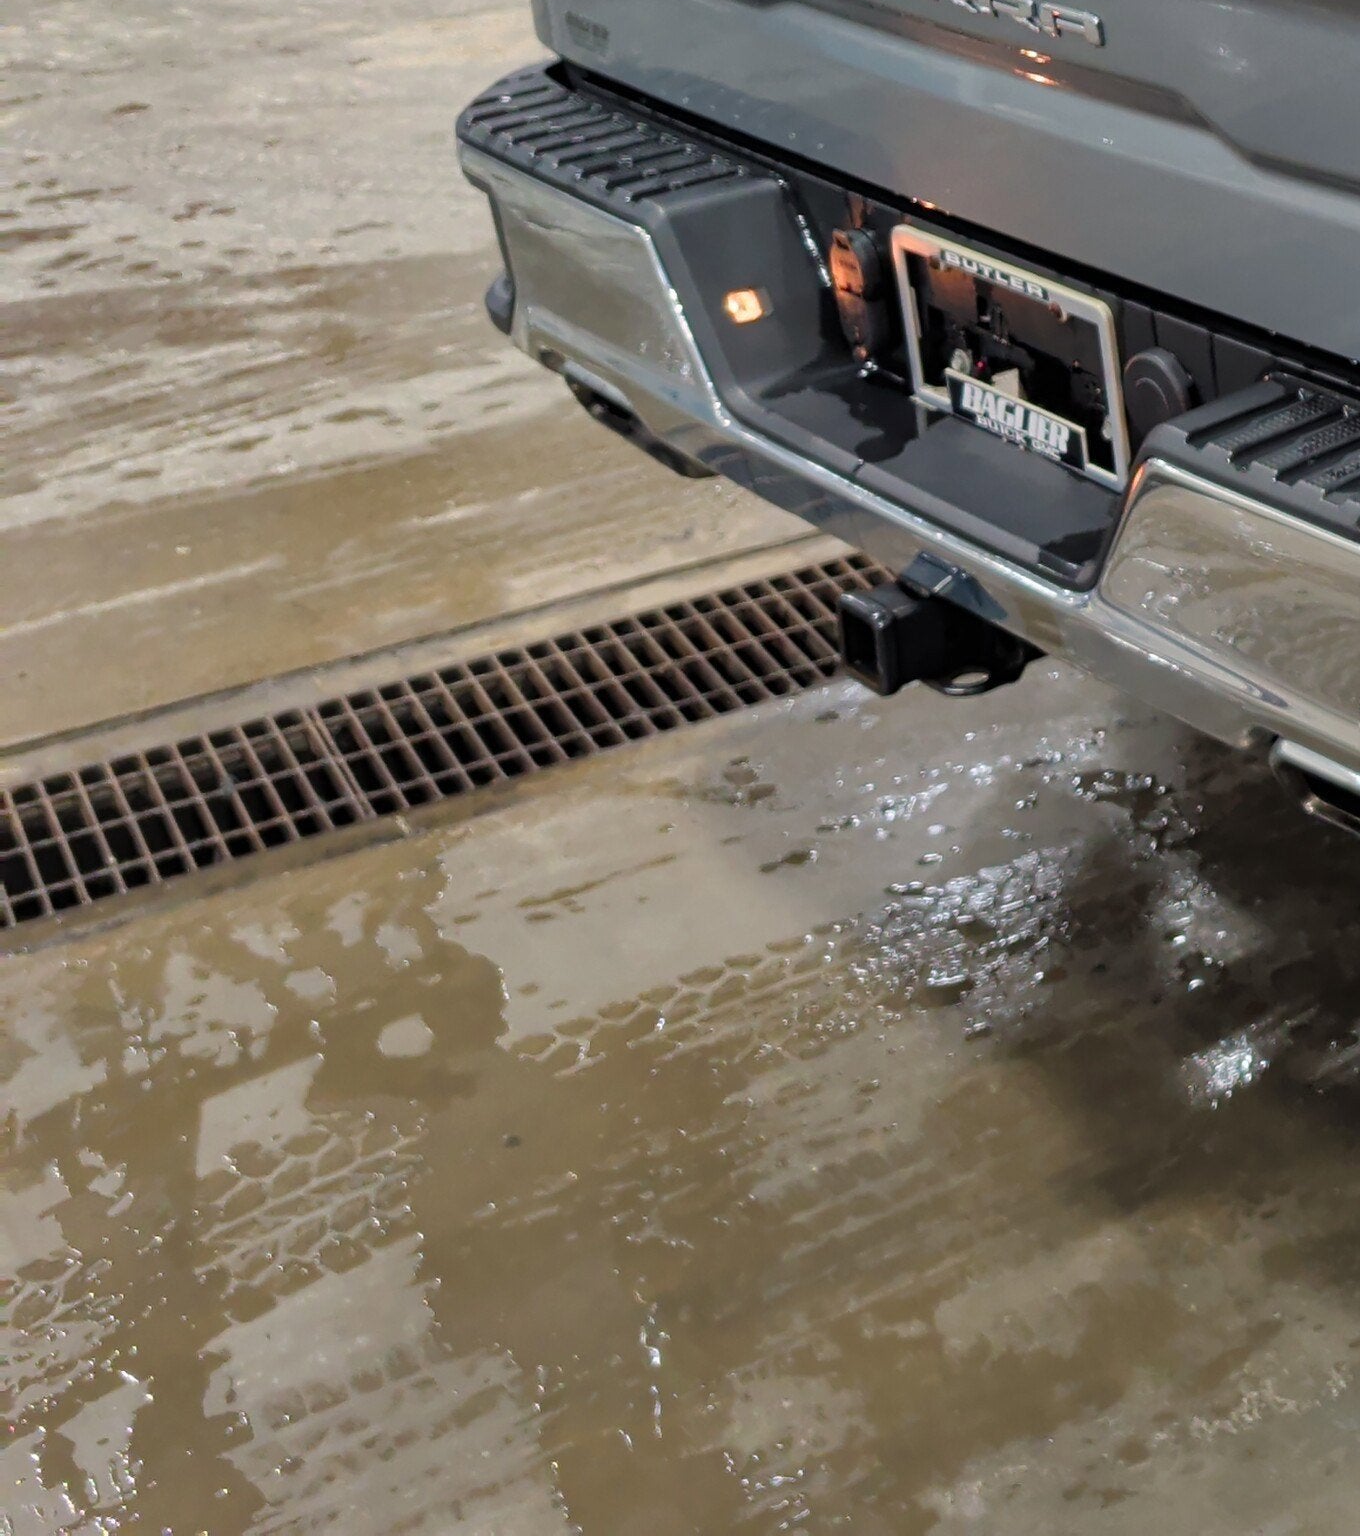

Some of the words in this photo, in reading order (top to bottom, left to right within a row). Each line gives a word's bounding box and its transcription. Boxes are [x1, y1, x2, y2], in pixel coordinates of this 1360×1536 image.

[944, 251, 1045, 299] BUTLER
[961, 381, 1070, 454] BAGLIER
[976, 415, 1026, 445] BUICK
